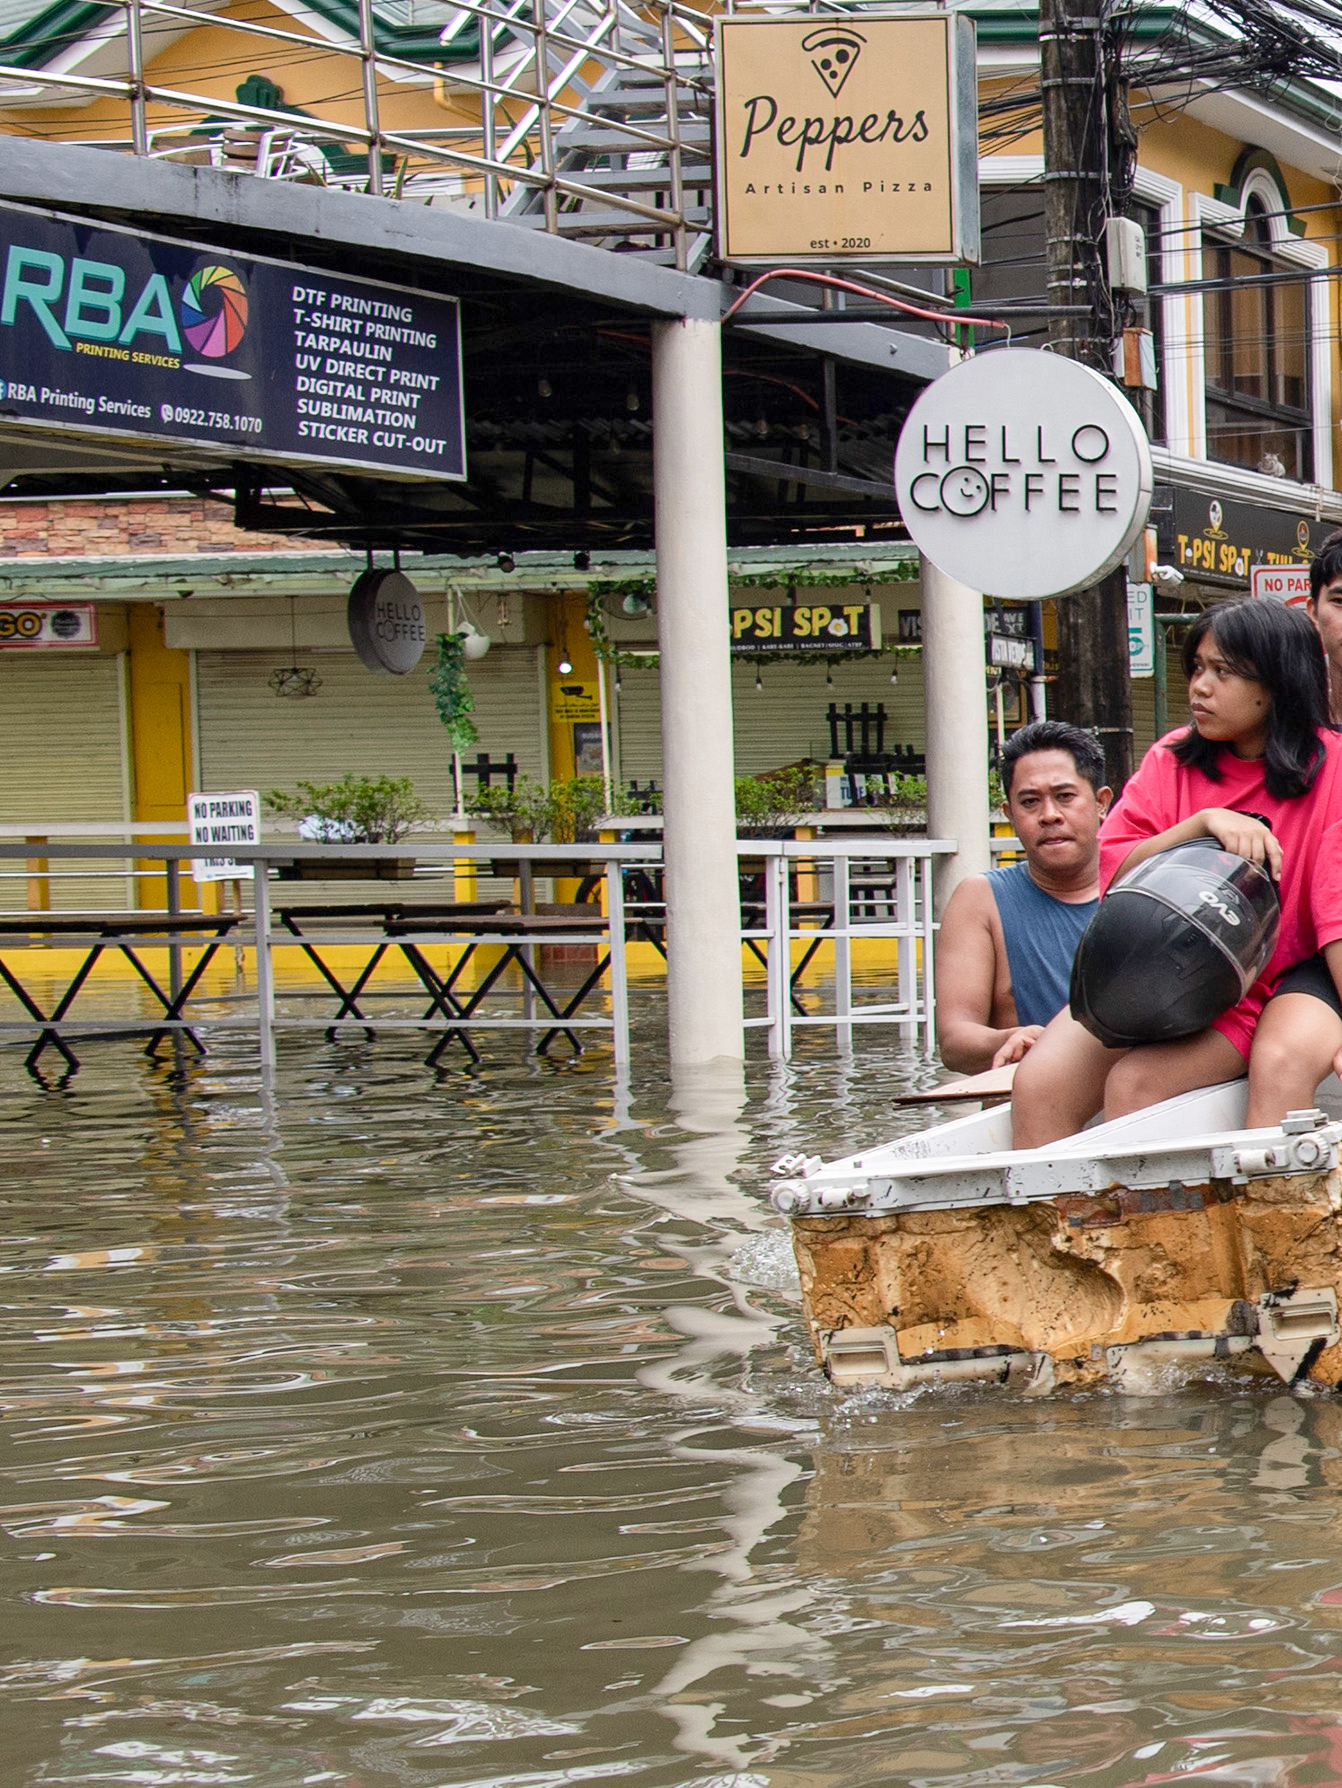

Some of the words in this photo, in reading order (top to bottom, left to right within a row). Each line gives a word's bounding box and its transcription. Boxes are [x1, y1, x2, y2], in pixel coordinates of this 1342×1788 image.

[739, 95, 929, 172] Peppers
[745, 182, 844, 194] Artisan
[863, 181, 933, 193] Pizza
[810, 238, 830, 249] est
[841, 237, 871, 249] 2020
[1, 244, 183, 354] RBA
[292, 286, 326, 306] DTF
[330, 294, 413, 323] PRINTING
[293, 309, 363, 335] T-SHIRT
[365, 322, 437, 349] PRINTING
[76, 342, 130, 361] PRINTING
[131, 352, 181, 369] SERVICES
[294, 331, 393, 361] TARPAULIN
[295, 354, 321, 371] UV
[325, 358, 386, 382] DIRECT
[390, 369, 440, 391] PRINT
[8, 382, 37, 402] RBA
[41, 386, 95, 415] Printing
[98, 396, 152, 418] Services
[175, 406, 263, 433] 0922.758.1070
[296, 376, 366, 400] DIGITAL
[370, 387, 421, 409] PRINT
[297, 399, 417, 429] SUBLIMATION
[298, 421, 369, 445] STICKER
[373, 431, 447, 455] CUT-OUT
[923, 424, 1110, 464] HELLO
[910, 465, 1118, 517] COFFEE
[1264, 578, 1283, 592] NO
[377, 602, 421, 621] HELLO
[733, 607, 782, 638] PSI
[793, 606, 864, 637] SPT
[376, 620, 425, 642] COFFEE
[194, 802, 208, 818] NO
[209, 800, 253, 818] PARKING
[195, 826, 209, 842] NO
[211, 824, 255, 842] WAITING
